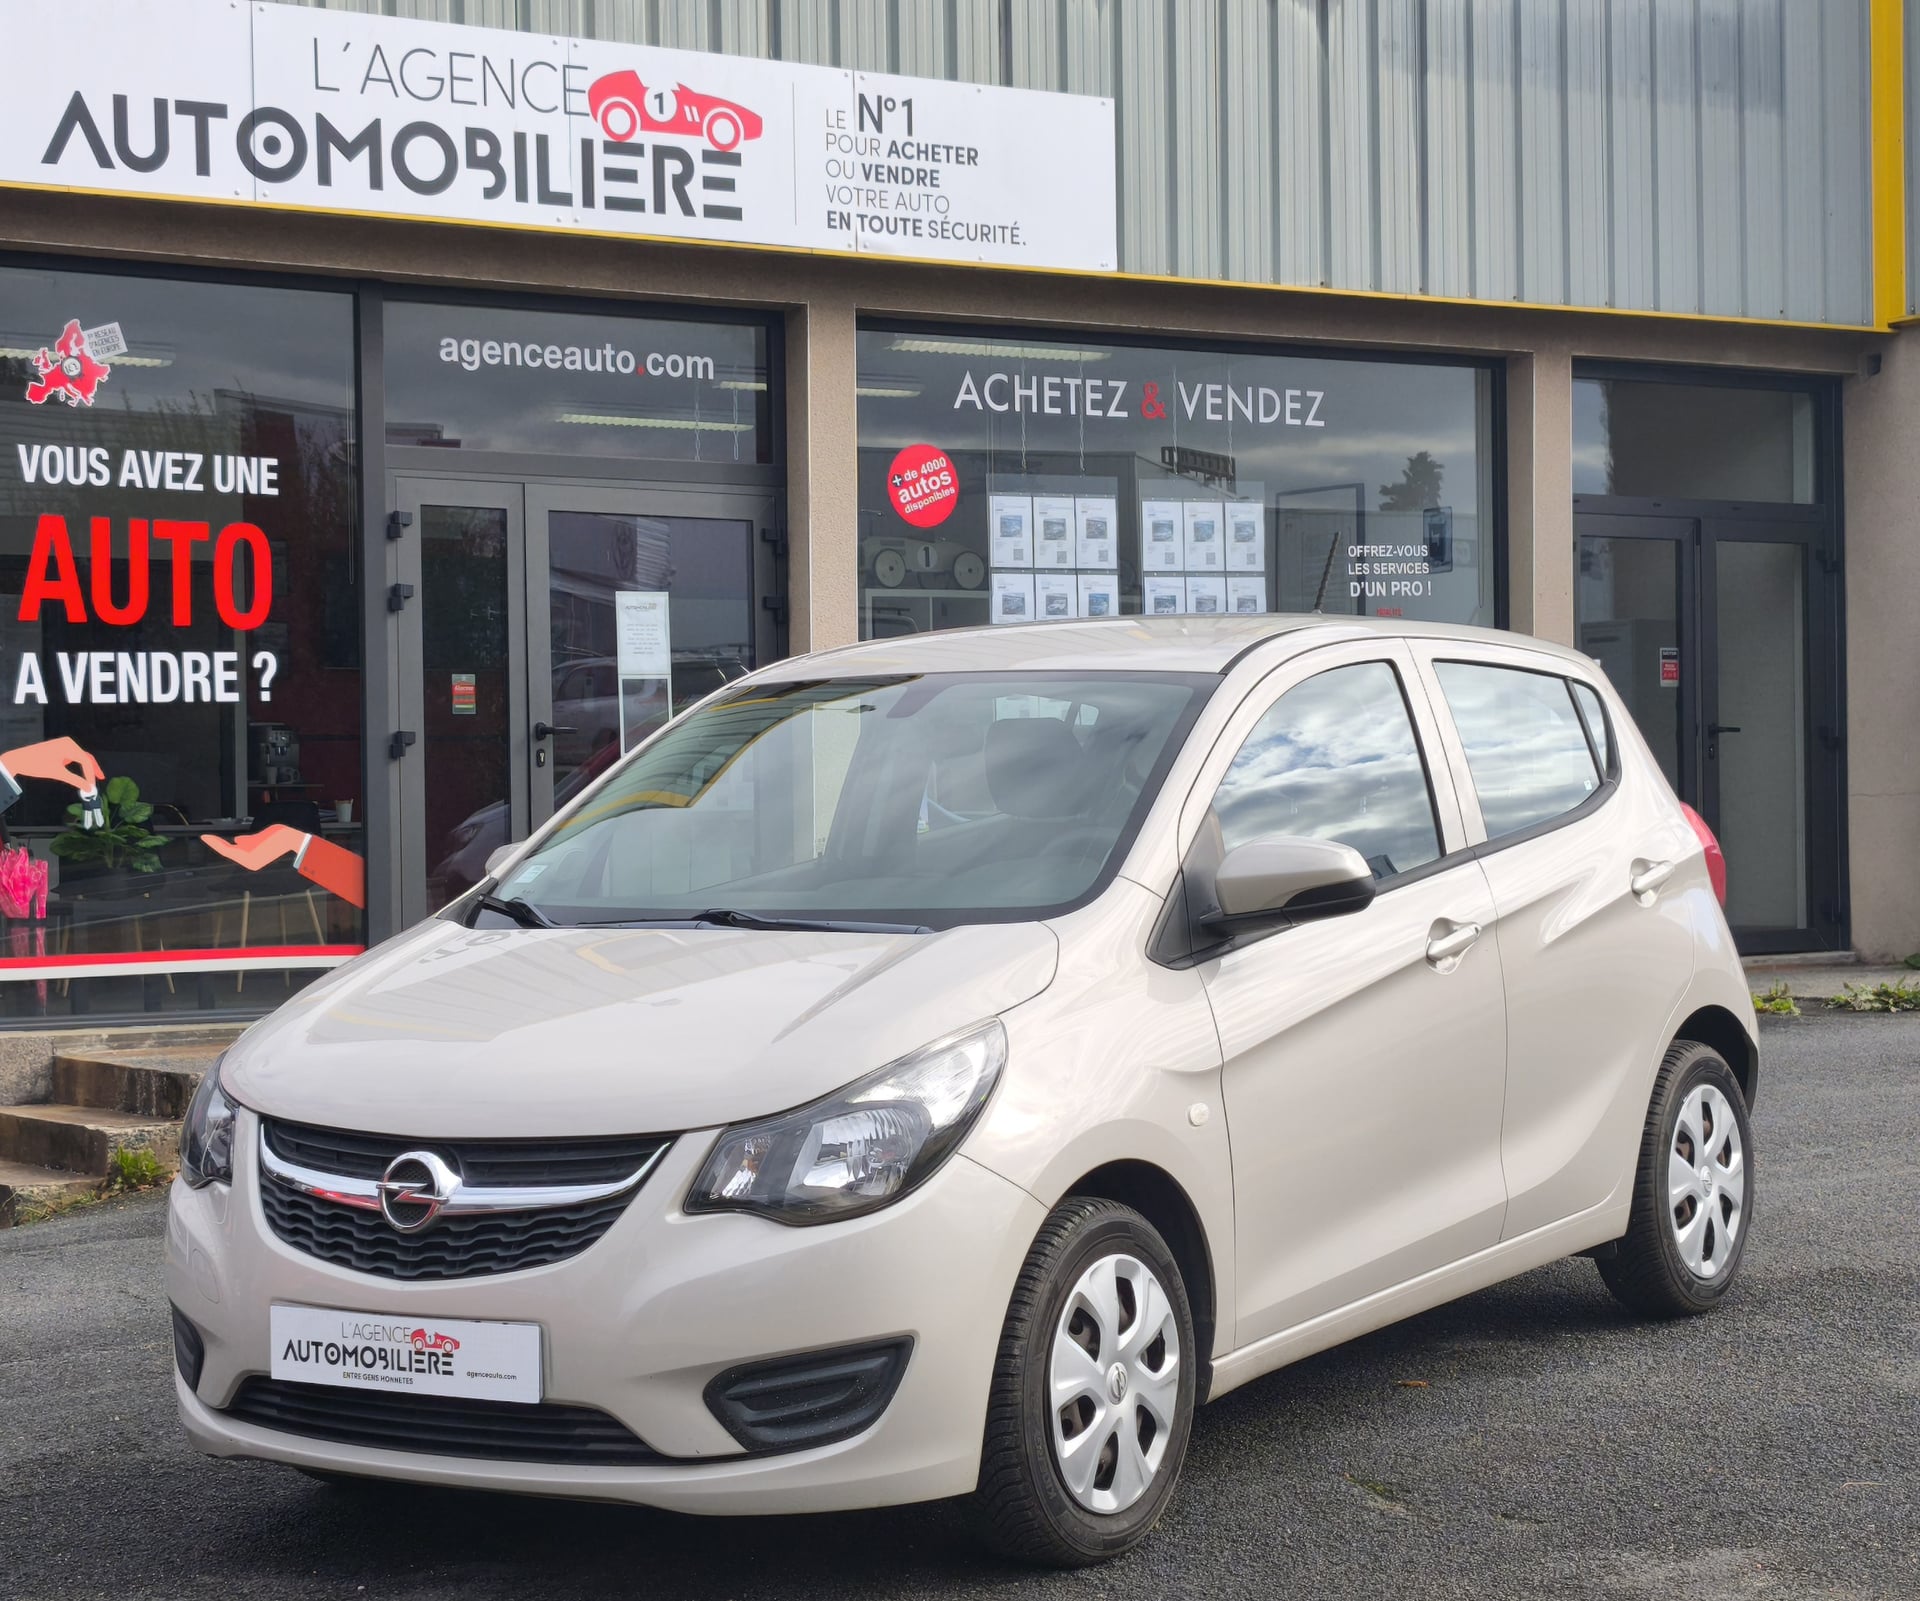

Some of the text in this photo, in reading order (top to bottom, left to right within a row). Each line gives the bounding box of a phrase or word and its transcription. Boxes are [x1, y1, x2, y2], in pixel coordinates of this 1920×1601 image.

[313, 37, 590, 118] L'AGENCE
[825, 108, 847, 131] LE
[40, 90, 744, 222] AUTOMOBILIERE
[825, 132, 980, 167] POUR ACHETER
[825, 158, 941, 189] OU VENDRE
[825, 184, 951, 215] VOTRE AUTO
[826, 210, 1028, 246] EN TOUTE SÉCURITÉ.
[439, 336, 715, 380] agenceauto.com
[953, 370, 1326, 428] ACHETEZ & VENDEZ
[16, 443, 279, 496] VOUS AVEZ UNE
[904, 469, 918, 481] de
[920, 456, 947, 475] 4000
[898, 471, 952, 504] autos
[904, 486, 956, 514] disponibles
[1347, 544, 1429, 558] OFFREZ-VOUS
[17, 513, 274, 632] AUTO
[1347, 562, 1430, 575] LES SERVICES
[1350, 581, 1387, 598] D'UN
[1391, 580, 1423, 597] PRO
[14, 650, 278, 705] A VENDRE ?
[341, 1321, 412, 1345] L'AGENCE
[282, 1338, 454, 1377] AUTOMOBILIERE
[343, 1371, 361, 1380] ENTRE
[363, 1373, 379, 1382] GENS
[466, 1370, 518, 1381] agenceauto.com
